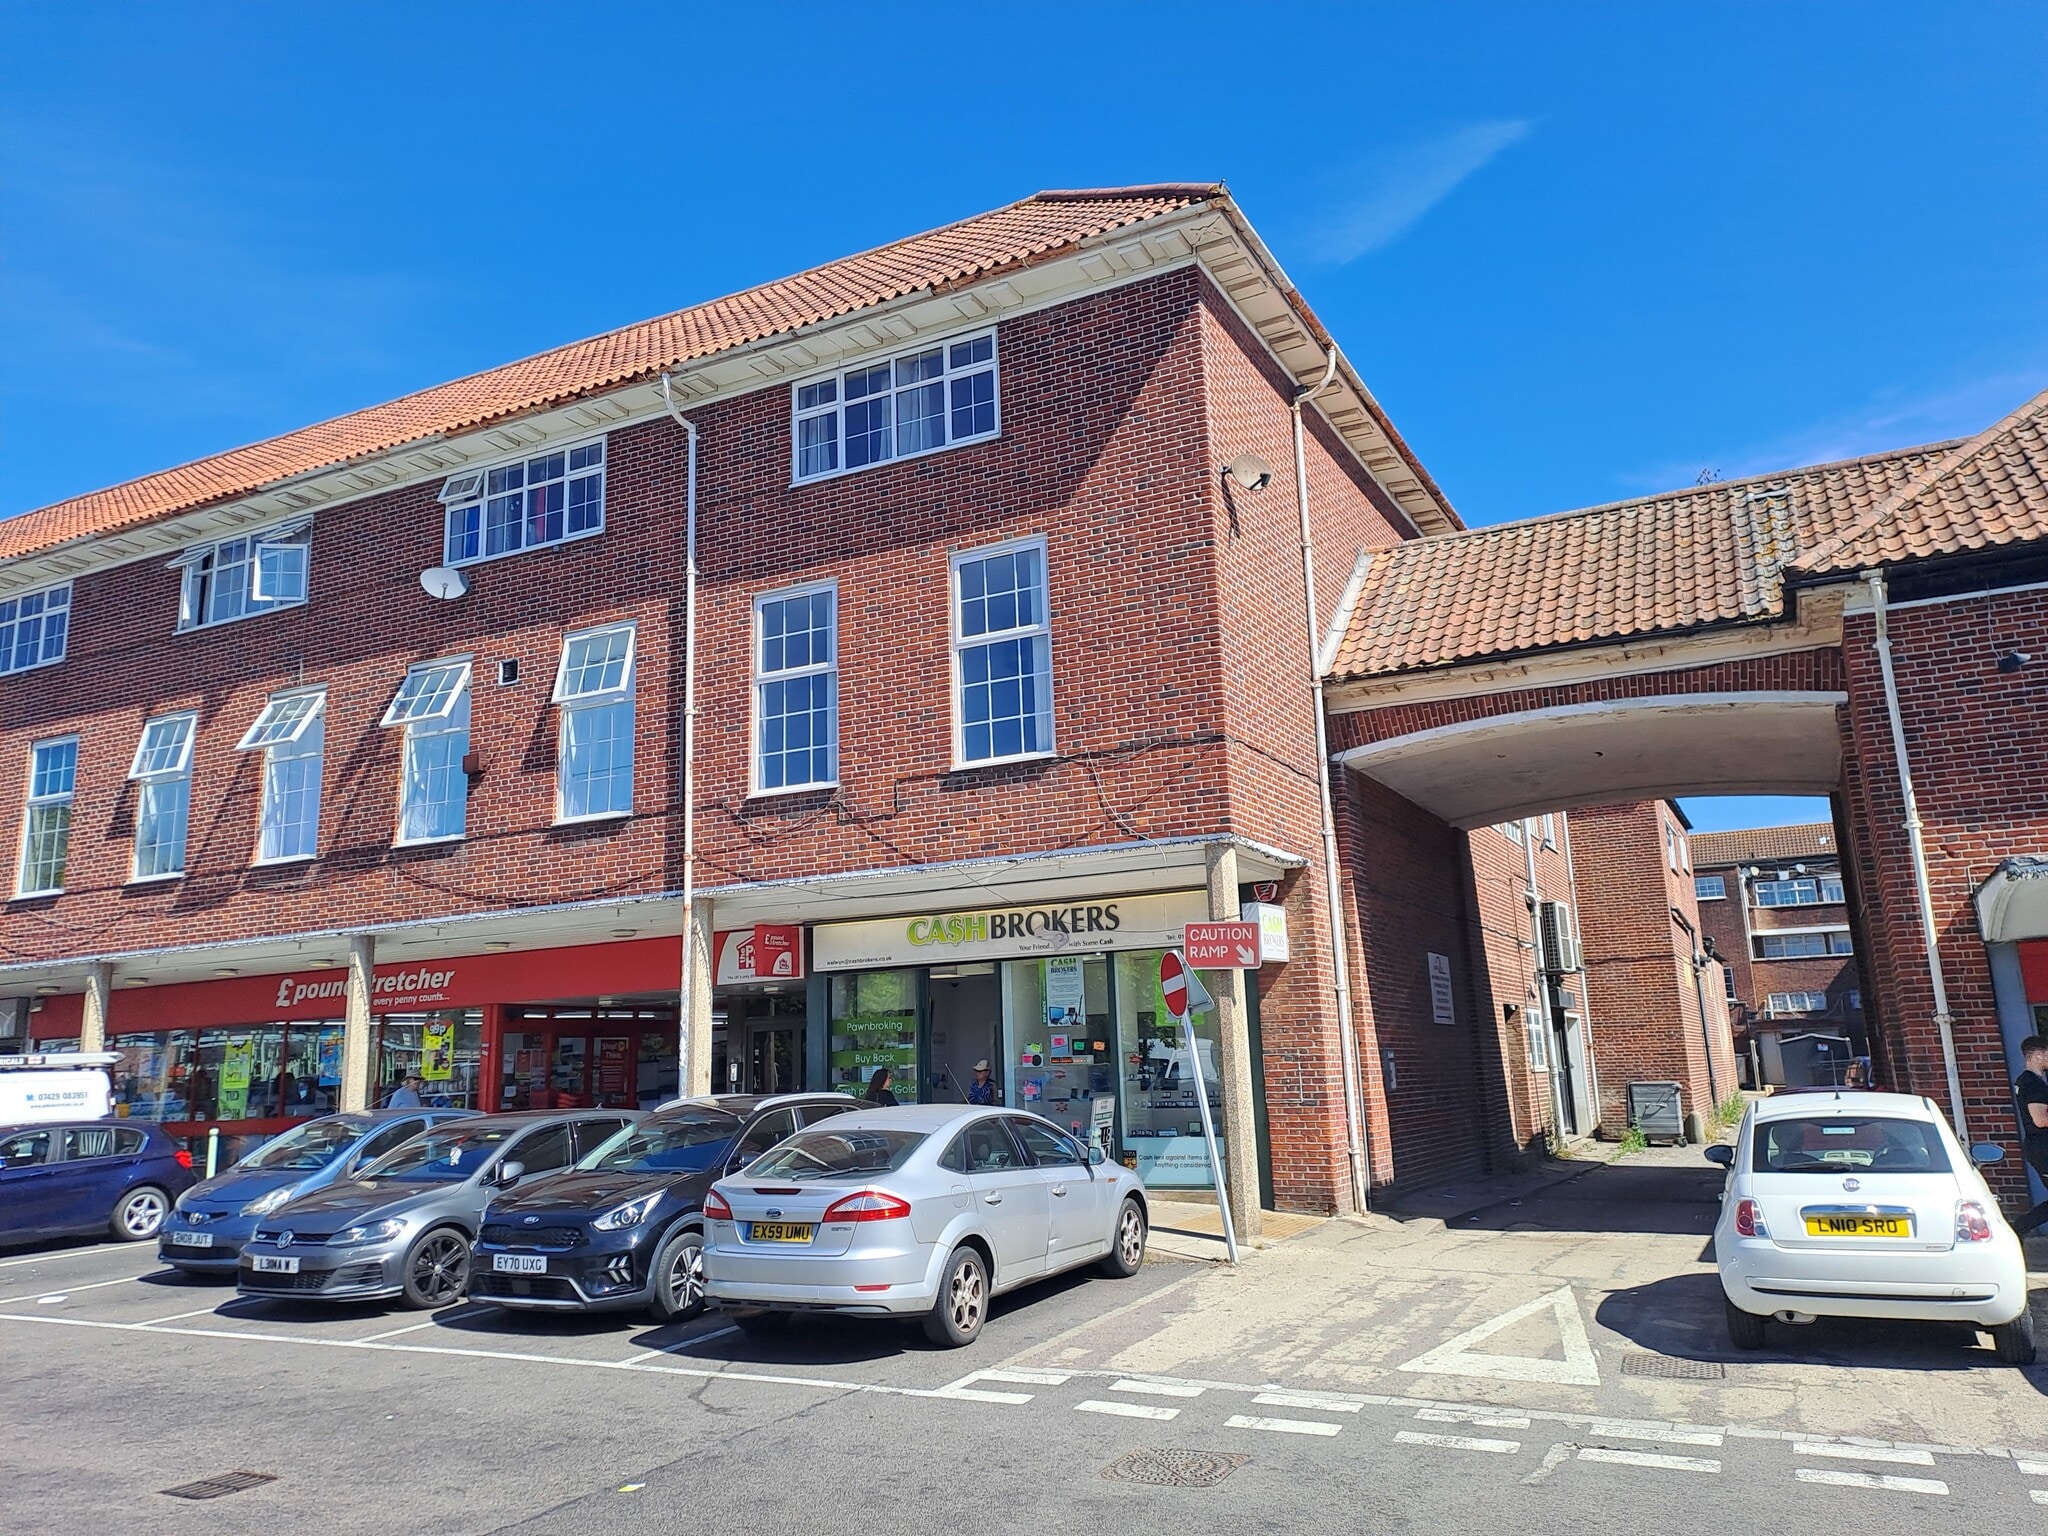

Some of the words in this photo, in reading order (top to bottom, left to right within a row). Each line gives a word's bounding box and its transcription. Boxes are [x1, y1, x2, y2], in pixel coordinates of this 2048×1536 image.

[1189, 928, 1252, 941] CAUTION
[1190, 945, 1229, 958] RAMP
[1051, 958, 1076, 966] CASH
[373, 997, 395, 1006] every
[394, 995, 417, 1005] penny
[847, 1021, 903, 1031] Pawnbroking
[855, 1054, 871, 1064] Buy
[873, 1053, 895, 1062] Back
[895, 1084, 917, 1093] Gold
[38, 1093, 60, 1101] 07429
[1817, 1218, 1857, 1232] LN10
[1862, 1219, 1898, 1233] SRO
[752, 1224, 783, 1239] EX59
[786, 1224, 810, 1240] UMU
[497, 1257, 519, 1269] EY70
